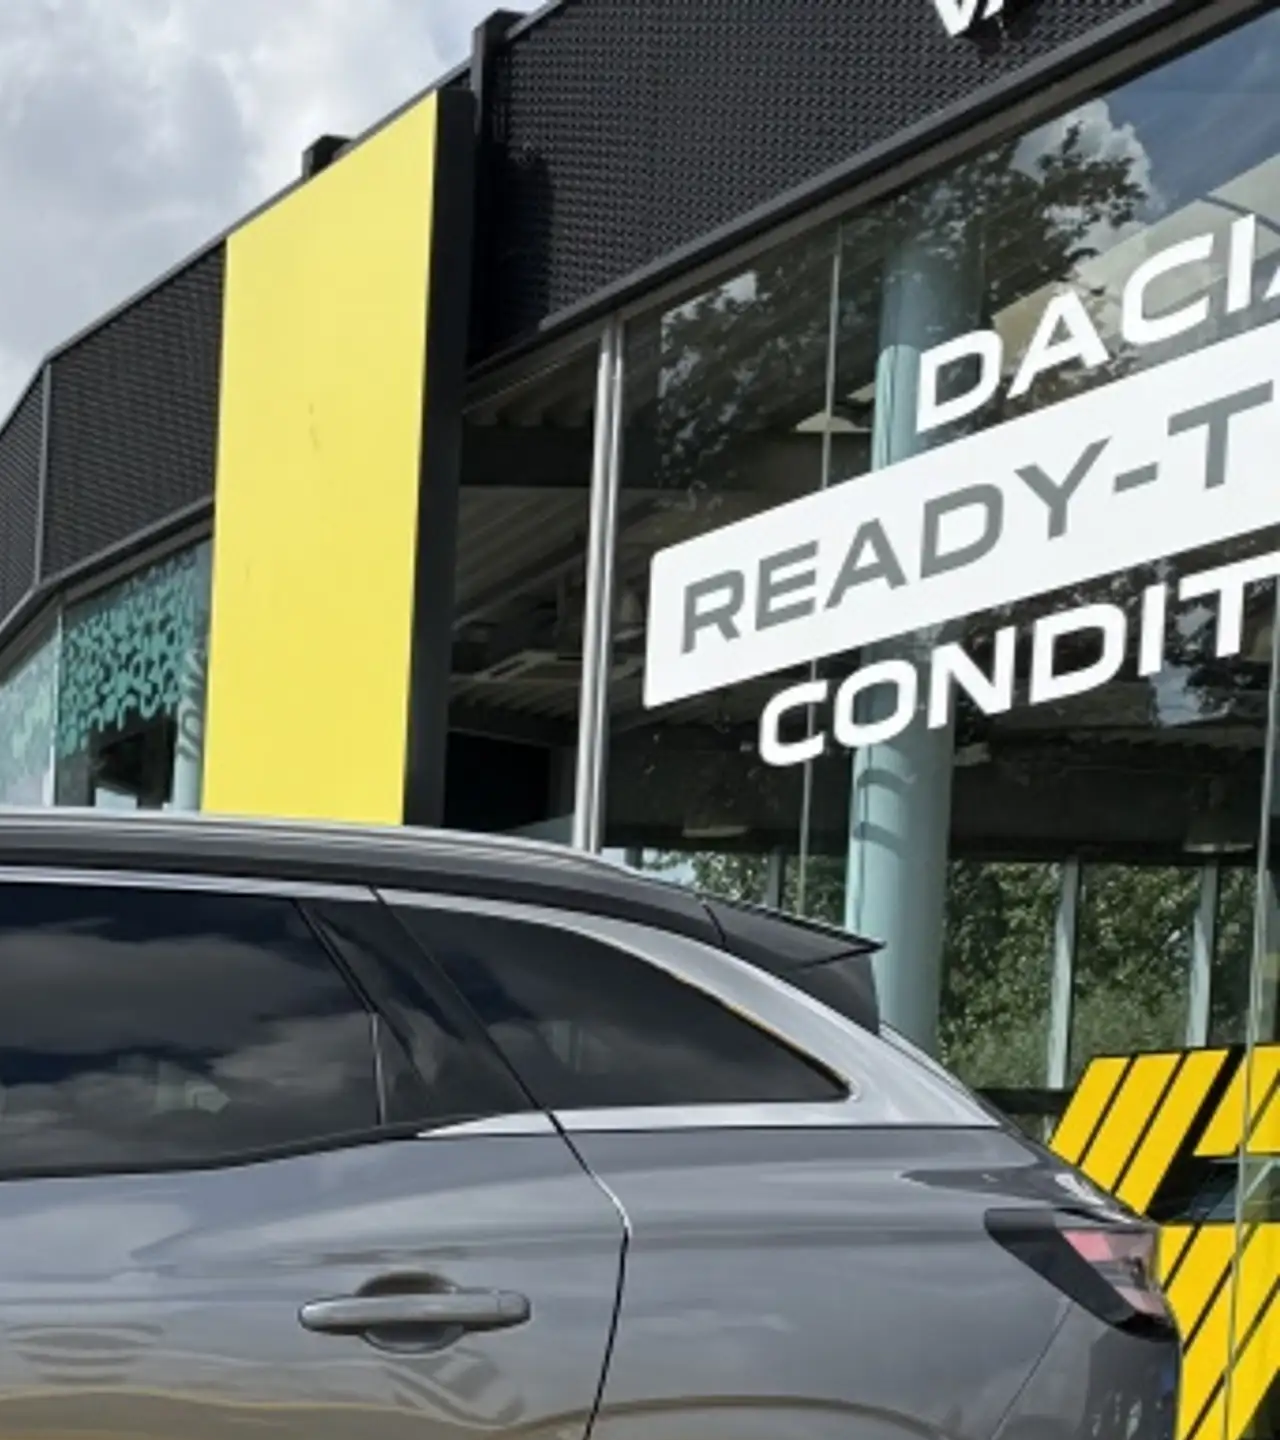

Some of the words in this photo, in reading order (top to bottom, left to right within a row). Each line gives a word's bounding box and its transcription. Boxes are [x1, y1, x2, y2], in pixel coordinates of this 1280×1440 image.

[916, 212, 1280, 434] DACI
[680, 379, 1274, 655] READY-T
[758, 549, 1280, 767] CONDIT
